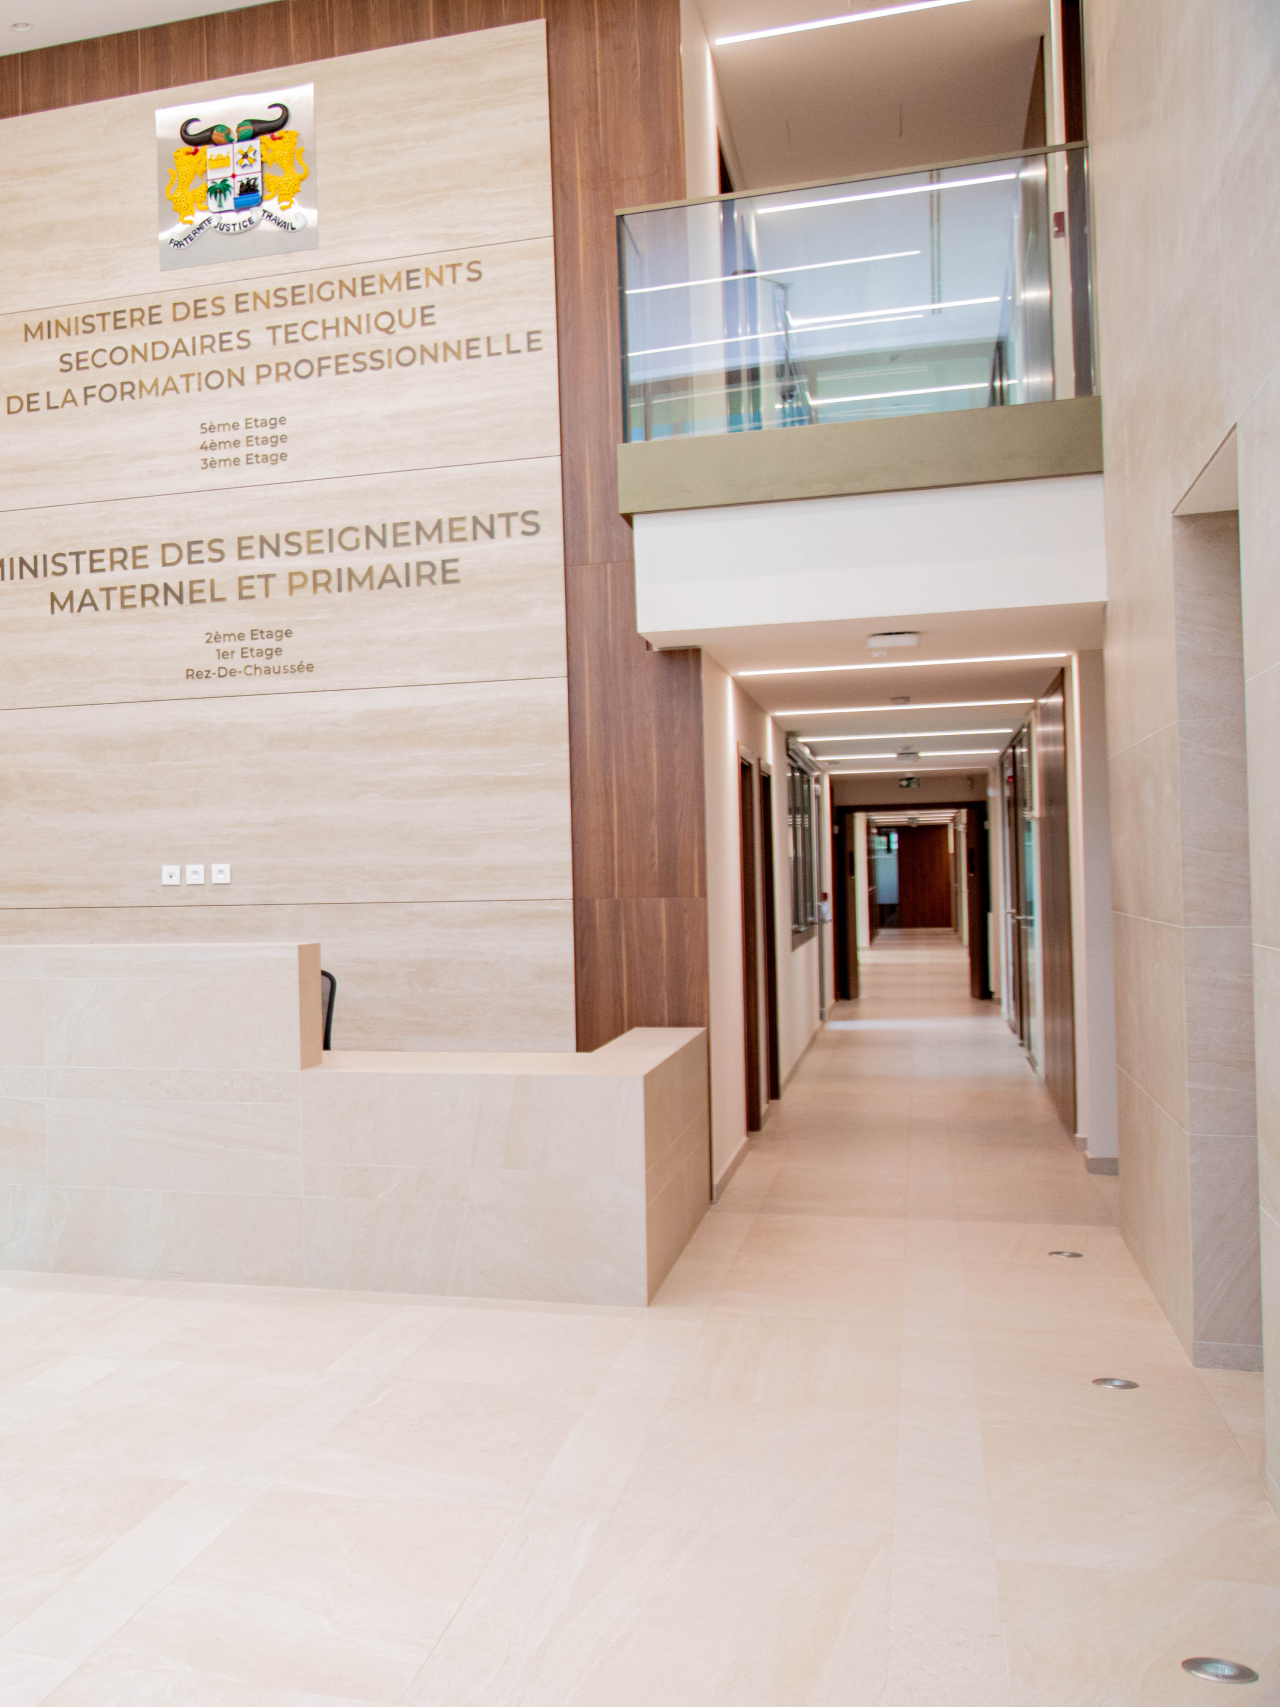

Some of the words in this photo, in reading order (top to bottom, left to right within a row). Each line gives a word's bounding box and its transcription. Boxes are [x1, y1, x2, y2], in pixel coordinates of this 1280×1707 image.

[213, 216, 255, 232] JUSTICE
[261, 209, 297, 231] TRAVAIL
[23, 305, 163, 343] MINISTERE
[172, 296, 226, 322] DES
[234, 260, 484, 314] ENSEIGNEMENTS
[59, 329, 252, 373] SECONDAIRES
[266, 305, 437, 347] TECHNIQUE
[83, 366, 246, 406] FORMATION
[255, 330, 544, 386] PROFESSIONNELLE
[199, 421, 240, 434] 5ème
[244, 416, 287, 429] Etage
[199, 439, 241, 452] 4ème
[245, 434, 288, 447] Etage
[200, 456, 241, 470] 3ème
[245, 451, 288, 465] Etage
[160, 536, 226, 568] DES
[237, 509, 542, 560] ENSEIGNEMENTS
[48, 577, 228, 616] MATERNEL
[237, 573, 277, 601] ET
[287, 557, 462, 596] PRIMAIRE
[205, 631, 246, 644] 2ème
[250, 628, 293, 641] Etage
[215, 648, 236, 660] 1er
[240, 646, 283, 659] Etage
[185, 660, 315, 680] Rez-De-Chaussée
